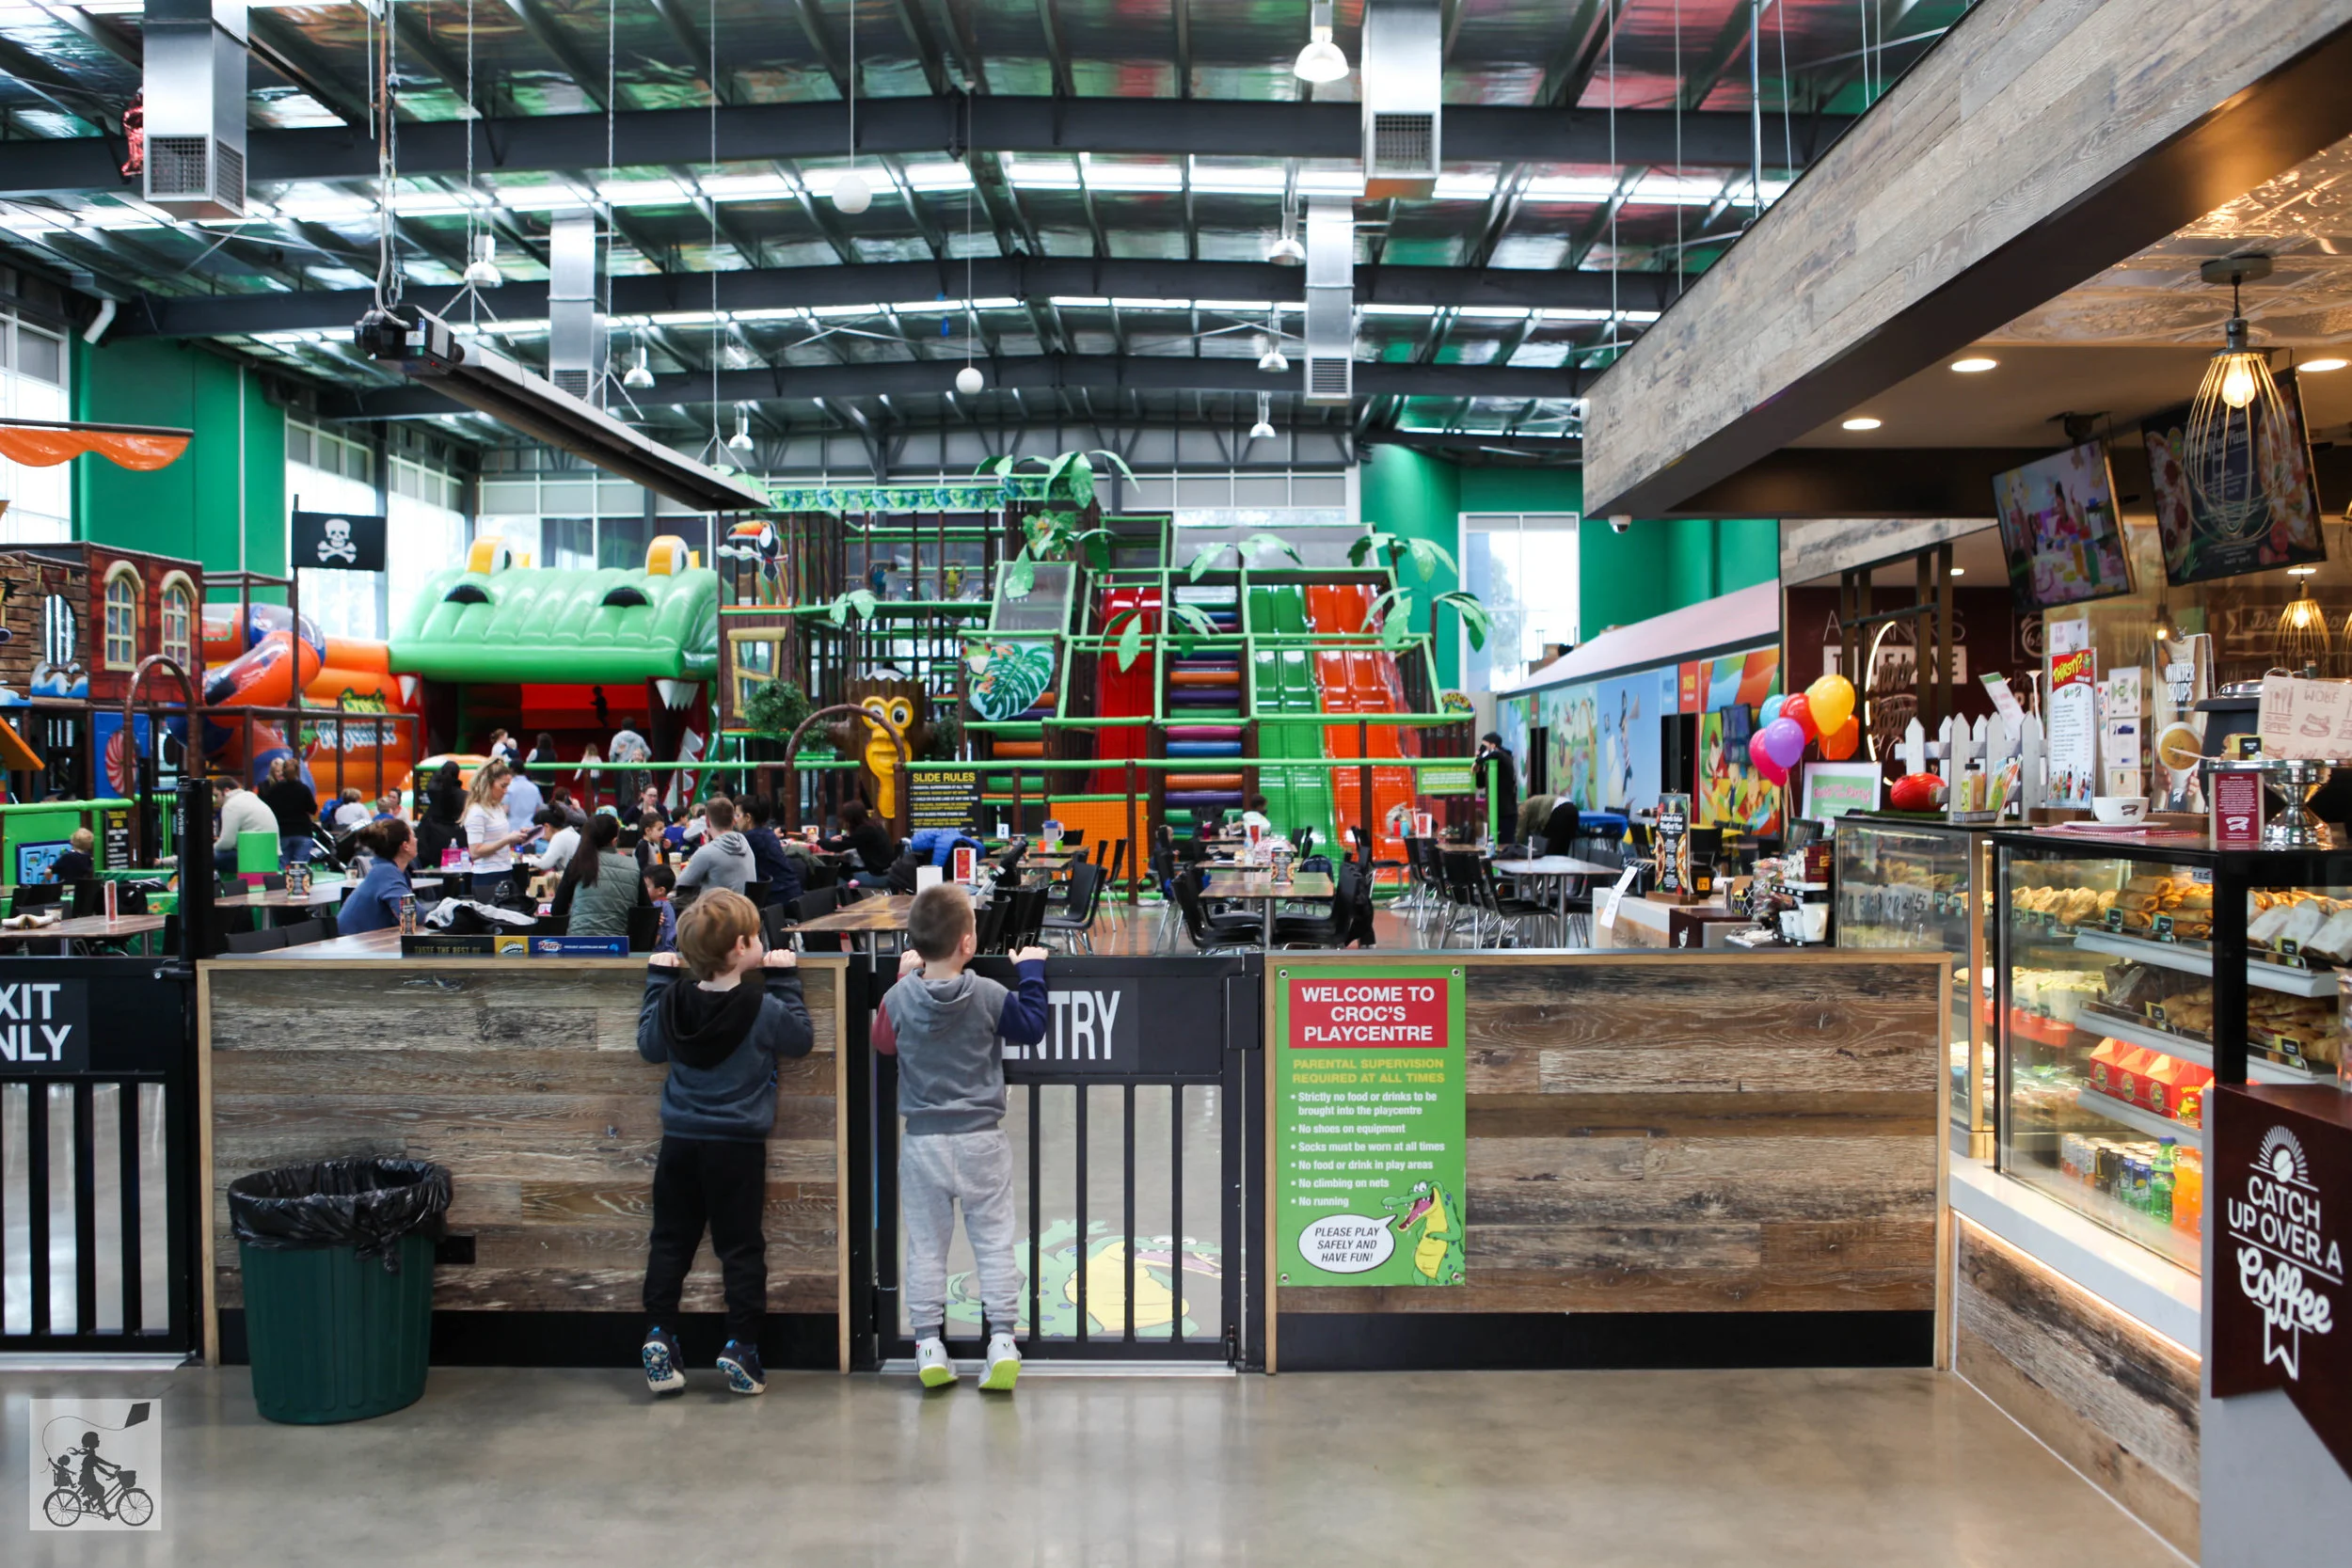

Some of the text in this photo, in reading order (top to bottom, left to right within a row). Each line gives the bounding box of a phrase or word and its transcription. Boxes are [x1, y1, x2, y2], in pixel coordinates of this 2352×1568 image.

[2053, 653, 2083, 684] THIRSTY?
[2165, 663, 2195, 684] WINTER
[2168, 683, 2192, 703] SOUPS
[913, 771, 976, 783] SLIDE RULES
[538, 941, 562, 950] Peters
[1301, 986, 1435, 1003] WELCOME TO
[0, 983, 61, 1020] XIT
[1330, 1006, 1406, 1022] CROC'S
[1001, 990, 1120, 1060] TRY
[1304, 1025, 1433, 1042] PLAYCENTRE
[0, 1024, 72, 1061] NLY
[1293, 1058, 1444, 1069] PARENTAL SUPERVISION
[1292, 1073, 1445, 1084] REQUIRED AT ALL TIMES
[1298, 1092, 1331, 1103] Strictly
[1347, 1092, 1368, 1101] food
[1382, 1092, 1411, 1101] drinks
[1413, 1093, 1423, 1101] to
[1425, 1091, 1437, 1101] be
[1298, 1105, 1422, 1117] brought into the playcentre
[1298, 1124, 1311, 1133] No
[1313, 1124, 1341, 1133] shoes
[1357, 1124, 1406, 1134] equipment
[1298, 1142, 1327, 1151] Socks
[1328, 1143, 1353, 1151] must
[1354, 1142, 1366, 1151] be
[1393, 1143, 1404, 1151] at
[1406, 1142, 1417, 1150] all
[1419, 1141, 1445, 1151] times
[1298, 1161, 1311, 1170] No
[1313, 1160, 1334, 1170] food
[1348, 1160, 1373, 1169] drink
[1375, 1160, 1384, 1169] in
[1386, 1160, 1406, 1171] play
[1407, 1162, 1434, 1170] areas
[1298, 1179, 1311, 1188] No
[1313, 1178, 1353, 1189] climbing
[1369, 1179, 1390, 1188] nets
[1298, 1196, 1349, 1208] No running
[2249, 1176, 2320, 1230] CATCH
[1314, 1227, 1380, 1237] PLEASE PLAY
[2228, 1198, 2343, 1275] UP OVER A
[1317, 1240, 1377, 1249] SAFELY AND
[1321, 1252, 1374, 1262] HAVE FUN!
[2237, 1247, 2332, 1334] Coffee
